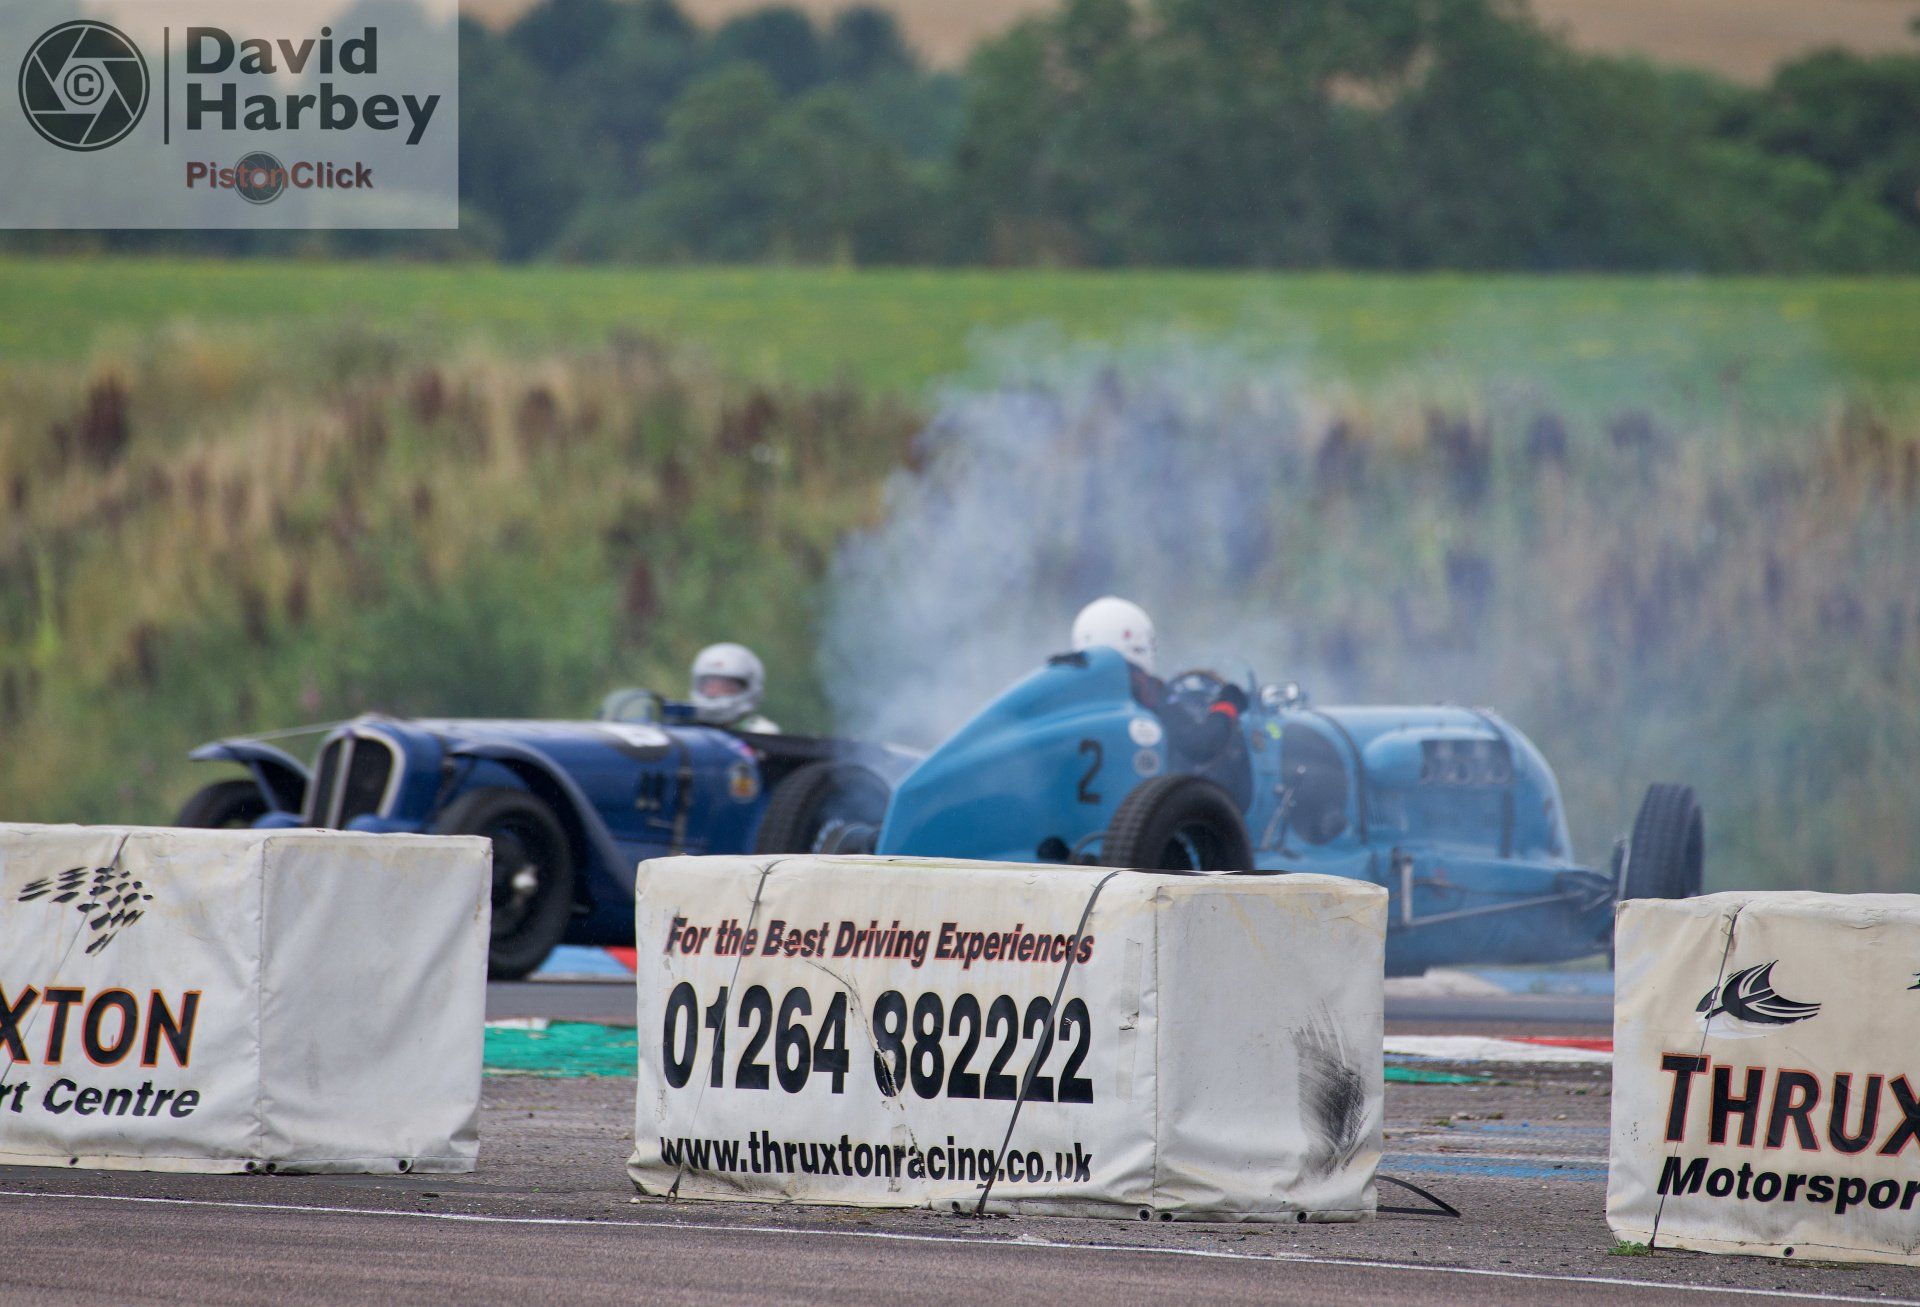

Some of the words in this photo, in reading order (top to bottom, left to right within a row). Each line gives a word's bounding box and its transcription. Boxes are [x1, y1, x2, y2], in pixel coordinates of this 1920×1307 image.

[1078, 738, 1103, 804] 2
[664, 917, 712, 957] For
[714, 918, 758, 957] the
[761, 919, 829, 958] Best
[832, 920, 931, 969] Driving
[934, 921, 1095, 970] Experiences
[0, 983, 202, 1068] XTON
[663, 981, 850, 1095] 01264
[871, 989, 1094, 1104] 882222
[42, 1077, 200, 1118] Centre
[1660, 1052, 1920, 1157] THRUX
